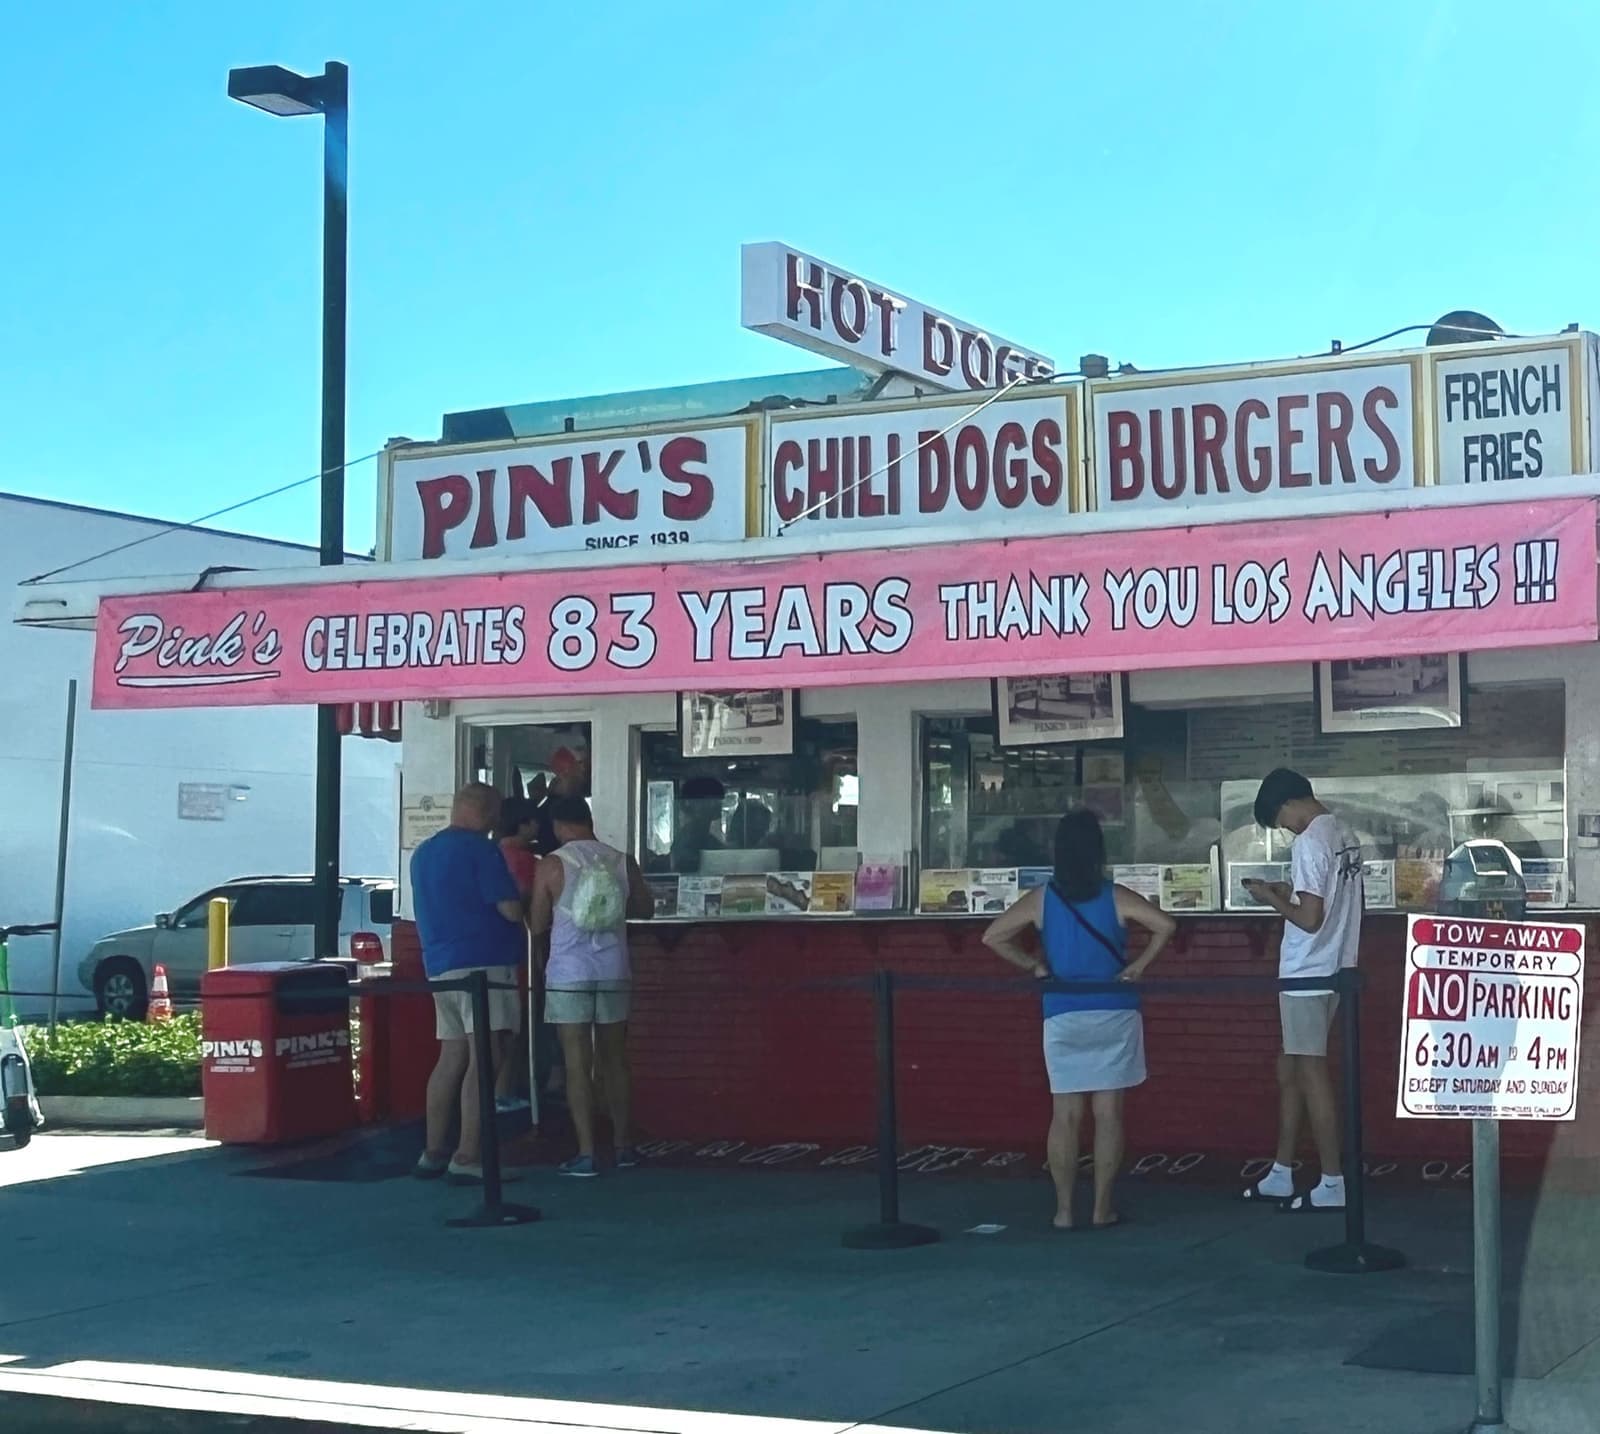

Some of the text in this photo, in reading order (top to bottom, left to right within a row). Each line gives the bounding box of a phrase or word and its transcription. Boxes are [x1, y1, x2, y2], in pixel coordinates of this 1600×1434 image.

[786, 253, 907, 357] HOT
[1445, 364, 1562, 422] FRENCH
[1108, 386, 1400, 500] BURGERS
[1464, 429, 1543, 483] FRIES
[773, 418, 1063, 522] CHILI DOGS
[416, 436, 714, 559] PINK'S
[585, 530, 689, 551] SINCE 1939
[114, 610, 282, 673] Pink's
[302, 605, 526, 672] CELEBRATES
[547, 591, 657, 671] 83
[679, 577, 912, 662] YEARS
[938, 569, 1090, 641] THANK
[1103, 565, 1199, 631] YOU
[1211, 558, 1291, 625] LOS
[1303, 543, 1500, 624] ANGELES
[1436, 950, 1558, 971] TEMPORARY
[1417, 972, 1571, 1020] NO PARKING
[202, 1040, 263, 1058] PINK'S
[275, 1030, 348, 1057] PINK'S
[1415, 1032, 1472, 1068] 6:30
[1475, 1045, 1499, 1069] AM
[1527, 1036, 1541, 1070] 4
[1546, 1047, 1567, 1070] PM
[1408, 1077, 1568, 1094] EXCEPT SATURDAY AND SUNDAY
